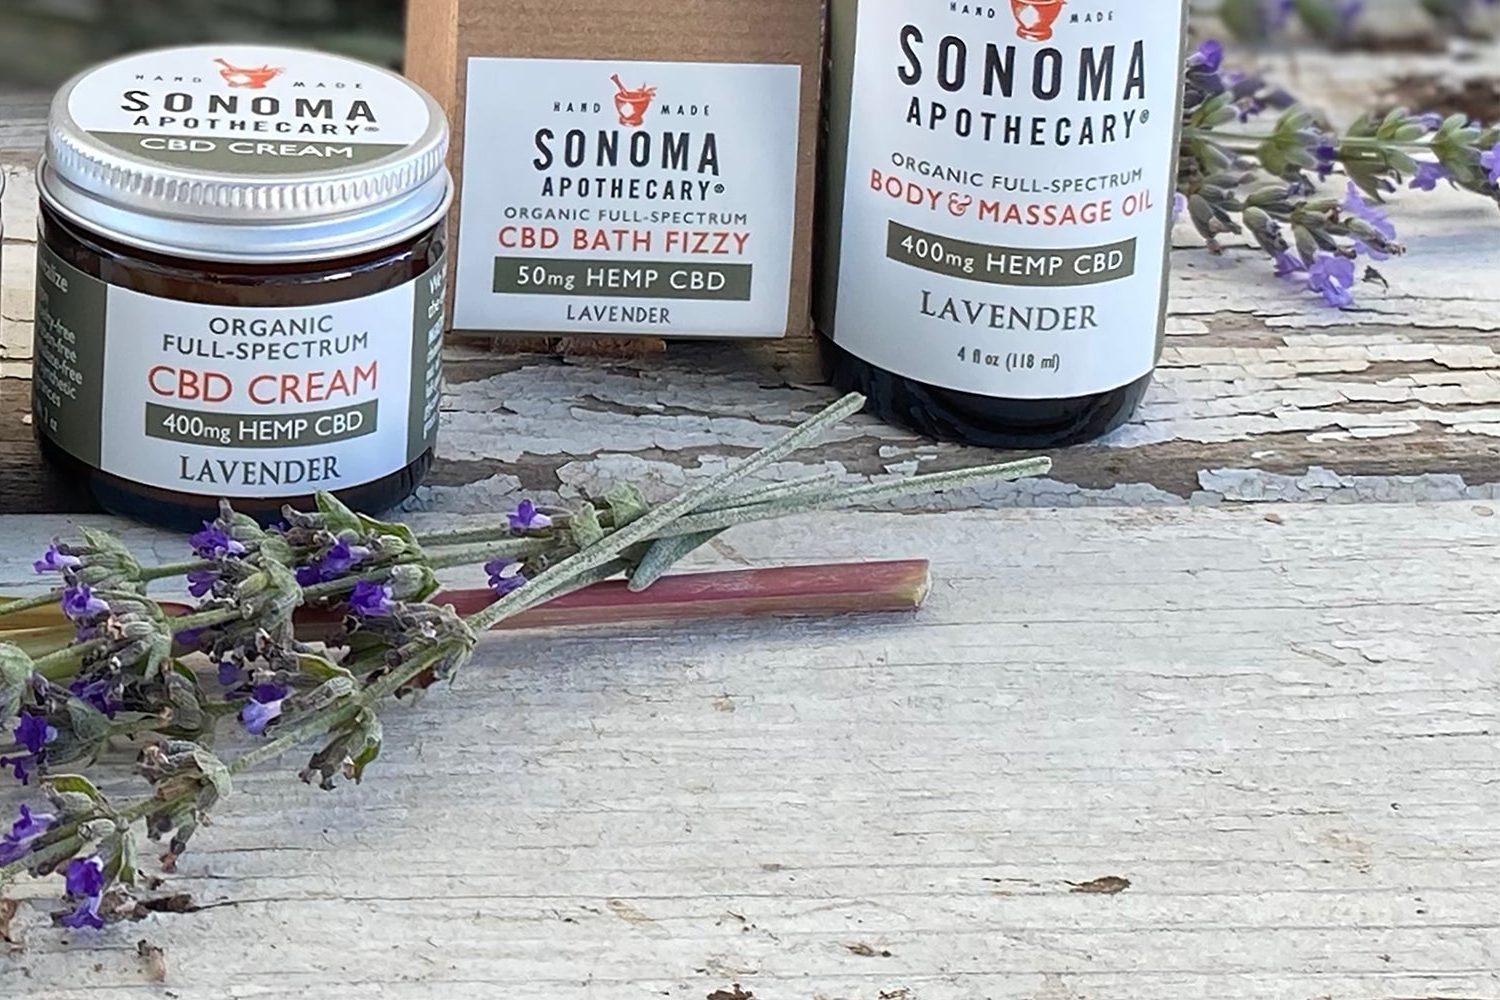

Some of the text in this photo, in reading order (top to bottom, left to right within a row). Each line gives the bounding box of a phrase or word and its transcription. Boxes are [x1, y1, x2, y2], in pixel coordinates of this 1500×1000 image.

[896, 23, 1146, 102] SONOMA
[293, 80, 363, 89] MADE
[120, 90, 377, 124] SONOMA
[553, 101, 710, 117] HAND MADE
[906, 96, 1150, 146] APOTHECARY®
[140, 137, 353, 159] CBD CREAM
[533, 127, 720, 176] SONOMA
[891, 152, 1143, 192] ORGANIC FULL-SPECTRUM
[541, 177, 725, 201] APOTHECARY®
[869, 168, 1153, 226] BODY & MASSAGE OIL
[503, 206, 748, 226] ORGANIC FULL-SPECTRUM
[498, 226, 750, 255] CBD BATH FIZZY
[900, 235, 1123, 277] 400mg HEMP CBD
[516, 265, 726, 291] 50mg HEMP CBD
[209, 314, 333, 337] ORGANIC
[566, 304, 671, 324] LAVENDER
[919, 290, 1099, 331] LAVENDER
[163, 331, 368, 361] FULL-SPECTRUM
[957, 346, 966, 361] 4
[984, 353, 999, 367] oz
[1006, 351, 1034, 371] (118
[1041, 352, 1061, 372] ml)
[147, 360, 377, 405] CBD CREAM
[162, 410, 363, 444] 400mg HEMP CBD
[179, 455, 341, 486] LAVENDER
